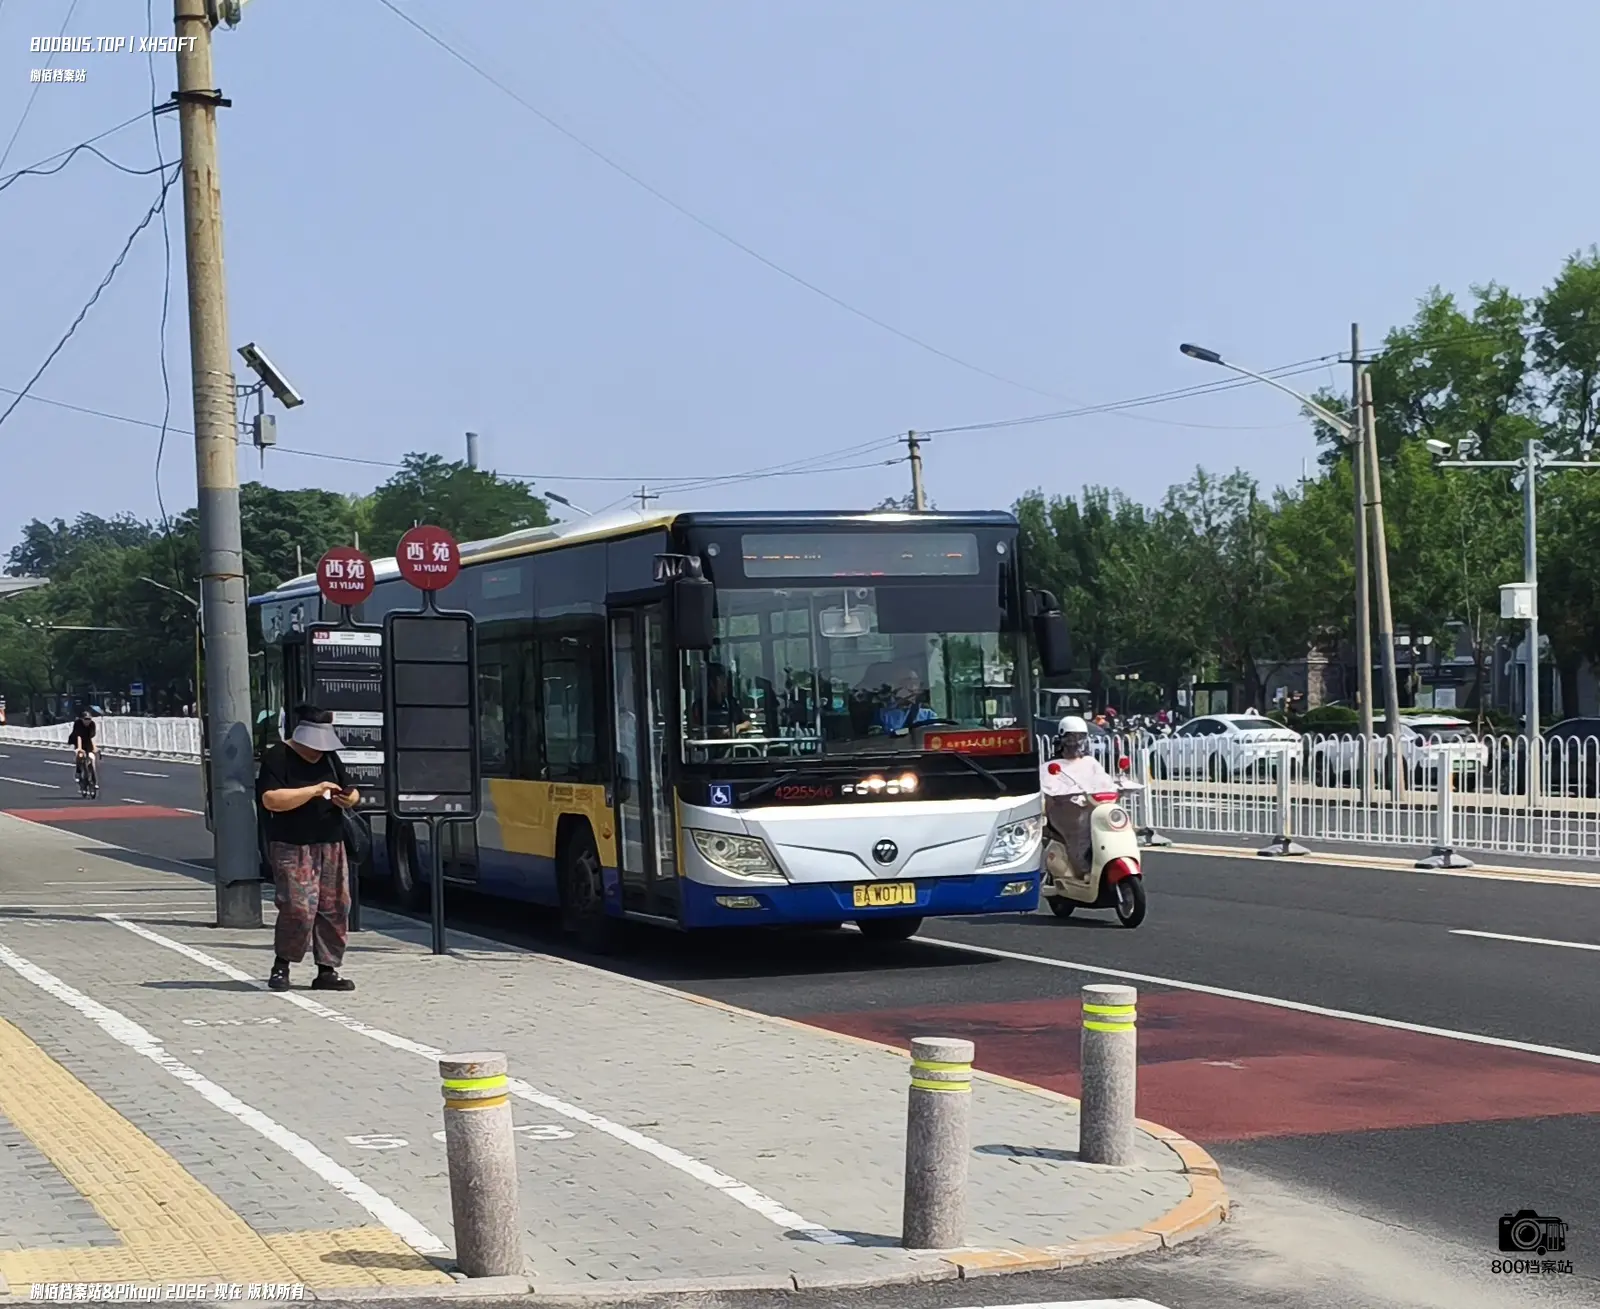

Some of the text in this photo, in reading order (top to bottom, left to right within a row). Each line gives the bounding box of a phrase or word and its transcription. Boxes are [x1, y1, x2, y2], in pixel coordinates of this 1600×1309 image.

[406, 542, 450, 562] 西苑
[325, 559, 365, 579] 西苑
[413, 563, 448, 573] XI YUAN
[328, 581, 365, 590] XI YUAN
[841, 780, 915, 795] FOO
